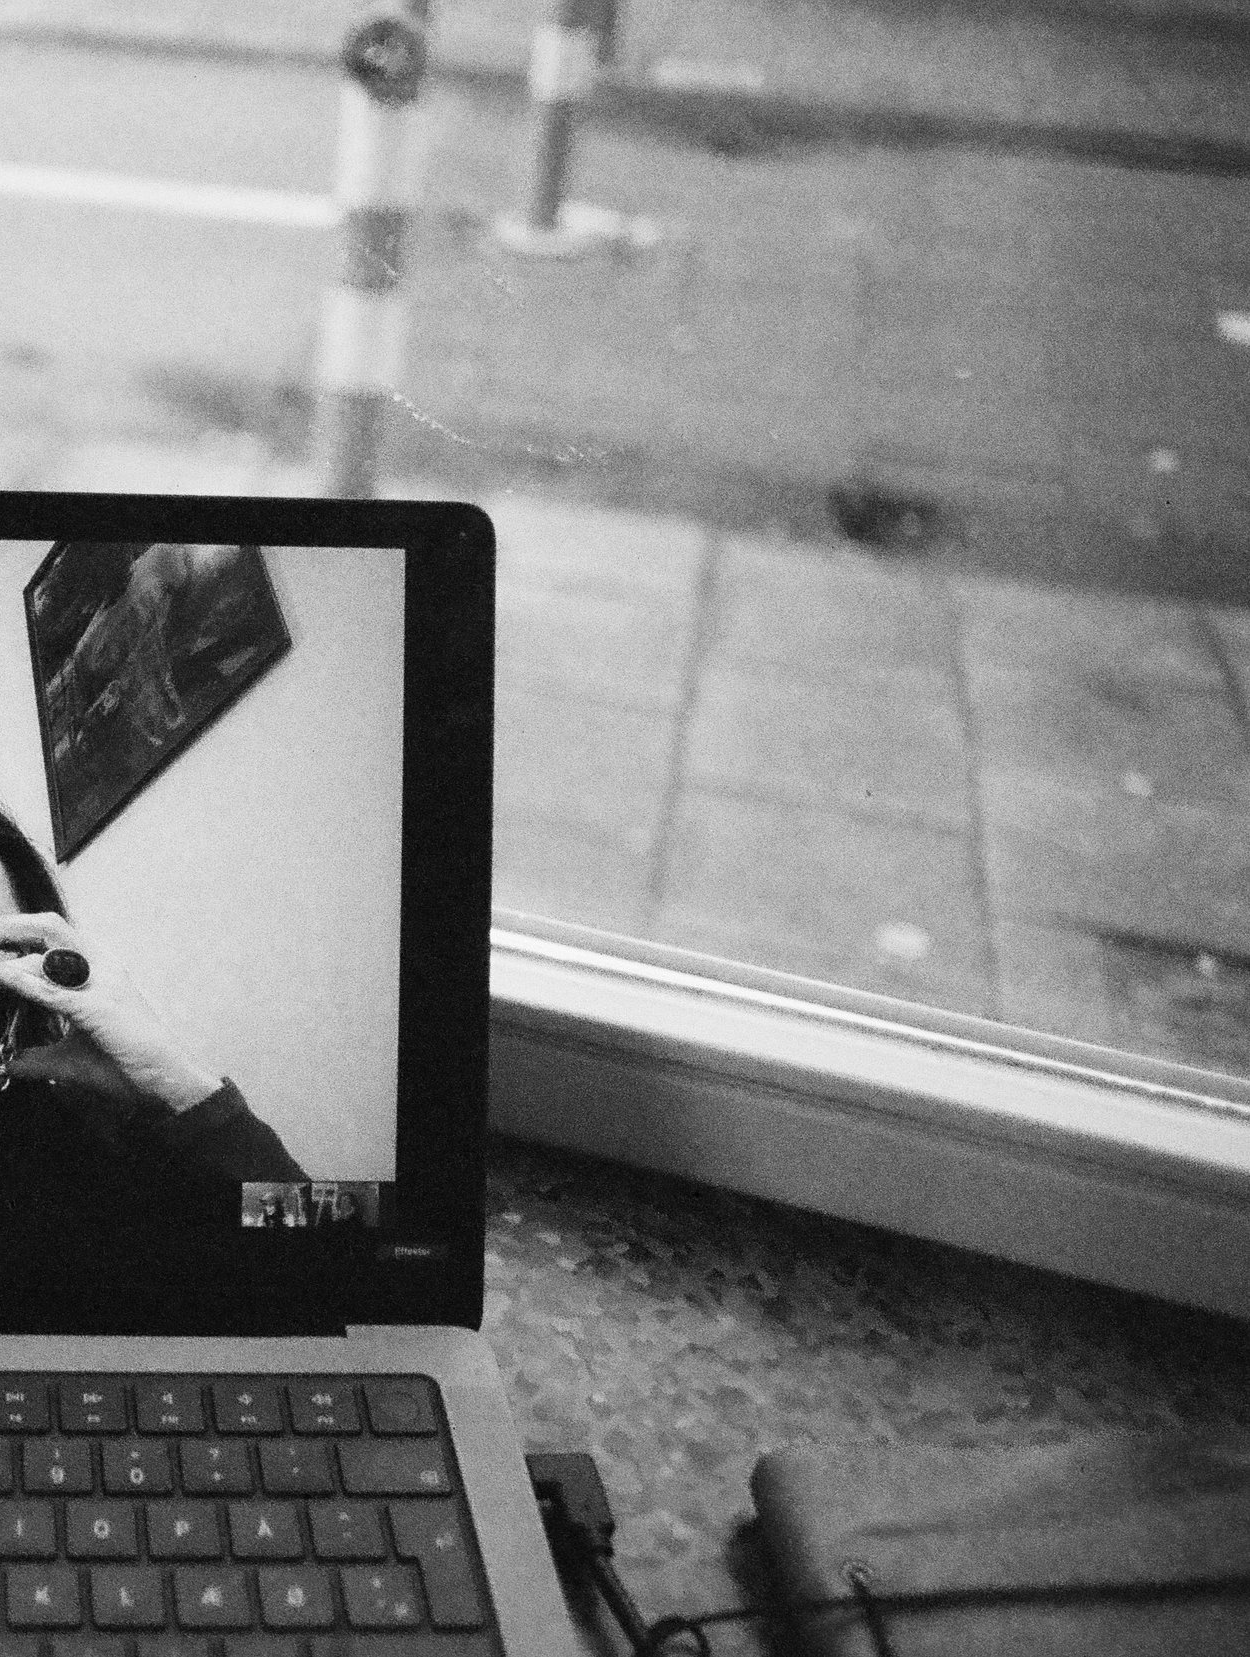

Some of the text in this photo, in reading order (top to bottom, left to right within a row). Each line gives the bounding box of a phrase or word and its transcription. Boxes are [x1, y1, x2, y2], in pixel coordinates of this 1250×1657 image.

[130, 1468, 144, 1484] 0
[94, 1519, 110, 1538] O
[120, 1587, 131, 1605] L
